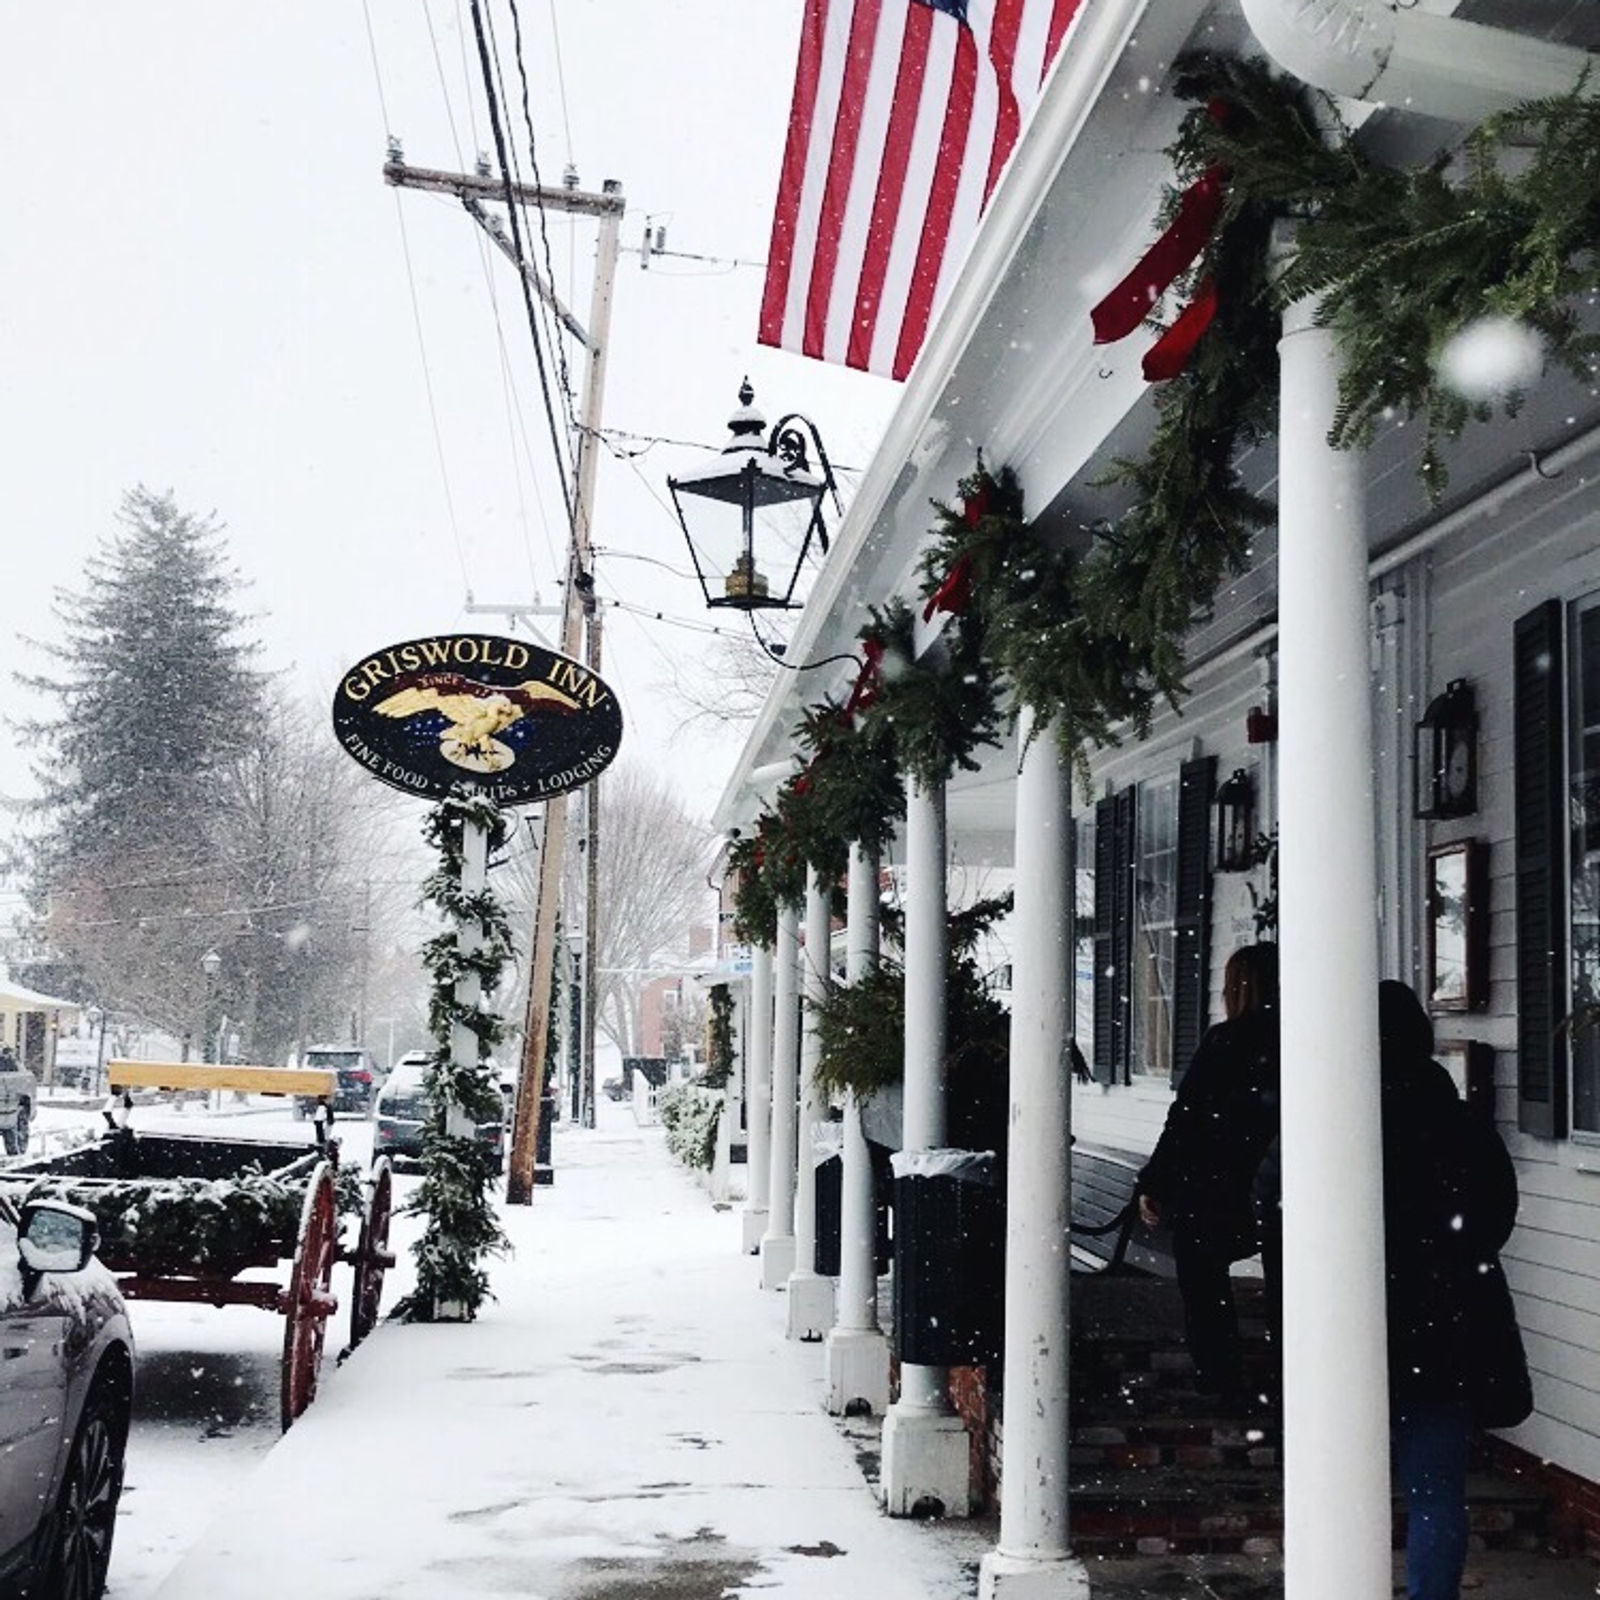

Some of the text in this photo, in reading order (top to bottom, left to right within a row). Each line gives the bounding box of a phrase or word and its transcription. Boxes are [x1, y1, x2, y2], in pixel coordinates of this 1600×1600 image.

[344, 638, 610, 708] GRISWOLD INN
[345, 733, 612, 799] FINE FOOD SIRITS LODGING
